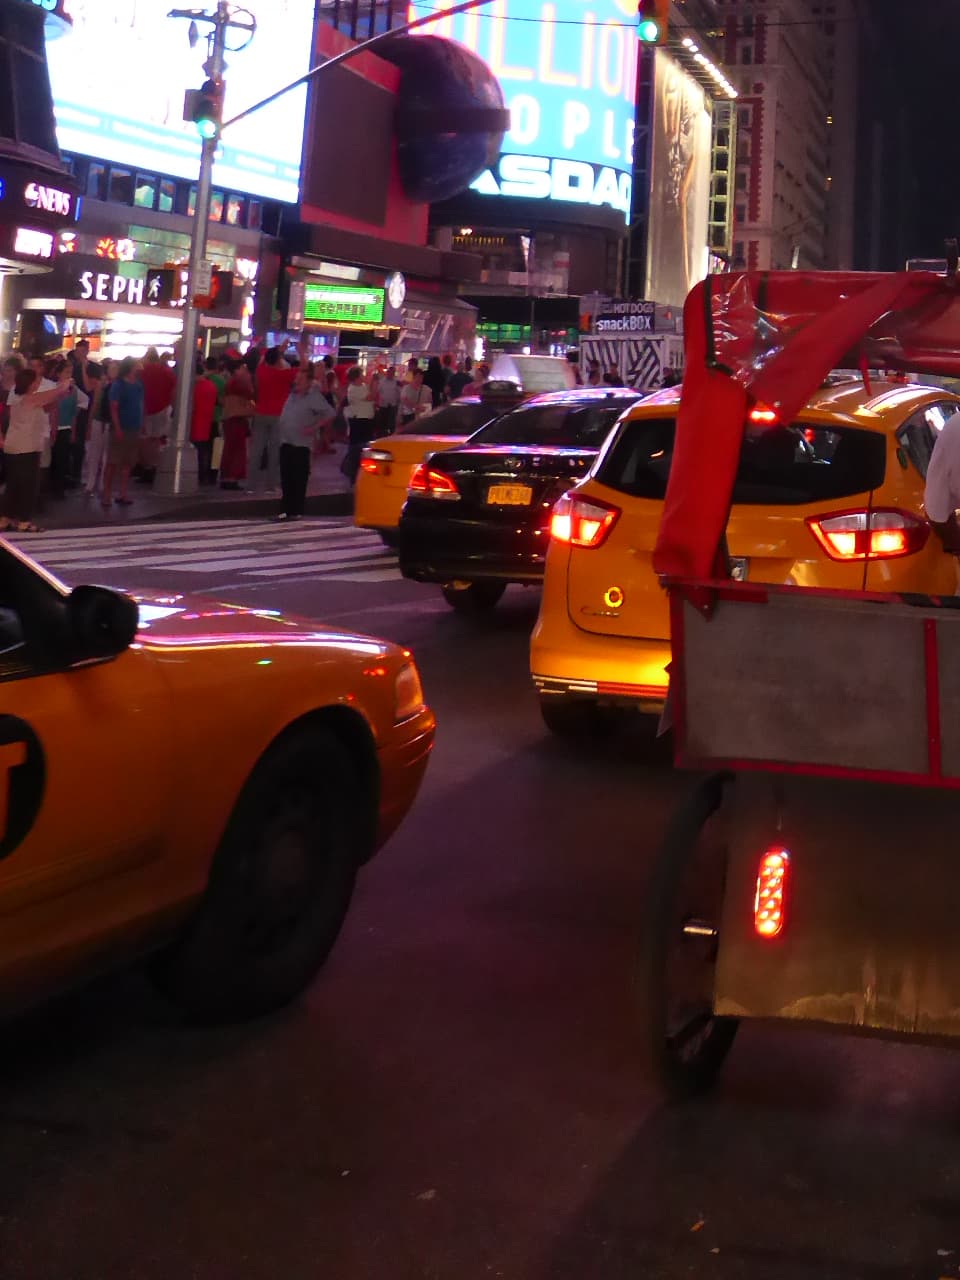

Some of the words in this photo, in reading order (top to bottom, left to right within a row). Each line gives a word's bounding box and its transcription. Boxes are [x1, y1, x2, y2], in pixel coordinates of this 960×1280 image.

[509, 94, 637, 165] OPLE
[469, 154, 632, 212] ASDAQ
[79, 271, 150, 304] SEPH
[597, 315, 652, 331] snackBOX
